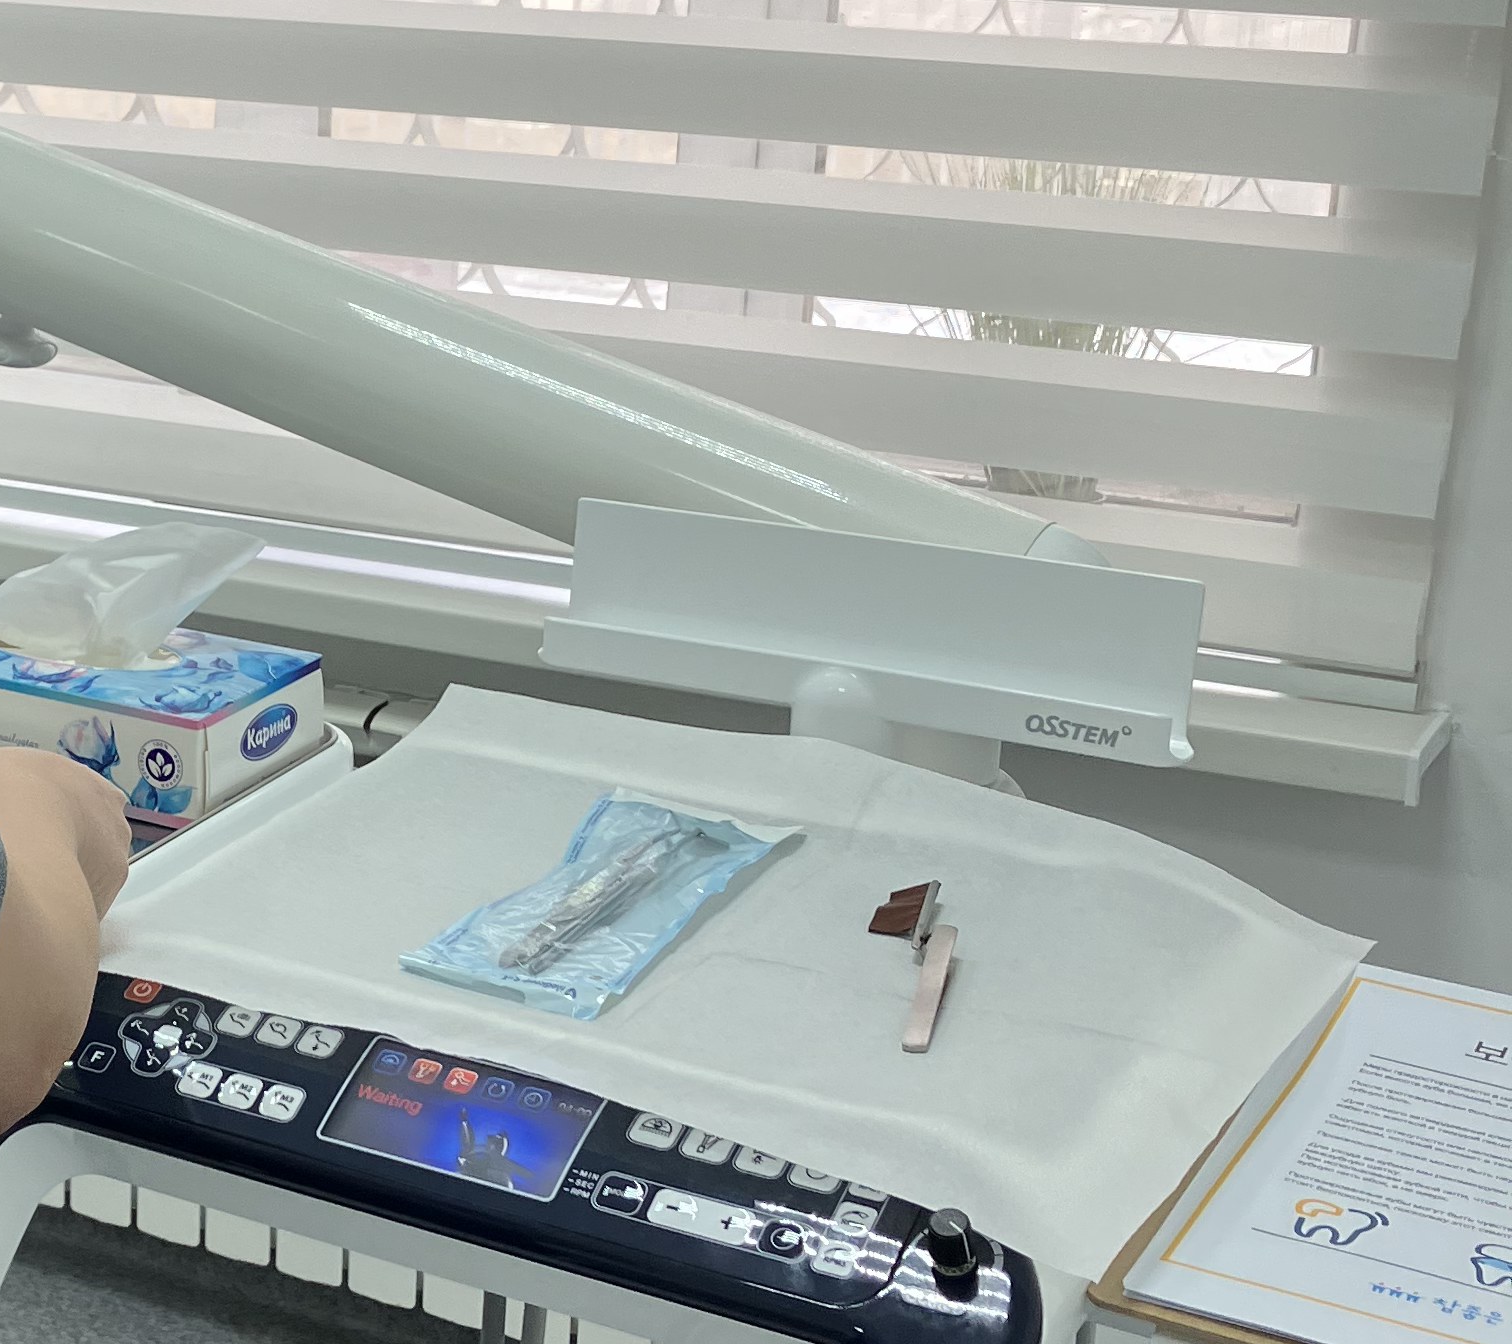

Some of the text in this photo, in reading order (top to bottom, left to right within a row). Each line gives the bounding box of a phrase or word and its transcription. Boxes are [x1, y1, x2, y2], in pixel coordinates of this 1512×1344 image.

[248, 714, 292, 751] Карина
[1025, 714, 1120, 748] OSSTEM
[90, 1050, 105, 1063] F
[358, 1084, 423, 1116] Waiting
[574, 1178, 595, 1190] SEC
[579, 1169, 600, 1181] MIN
